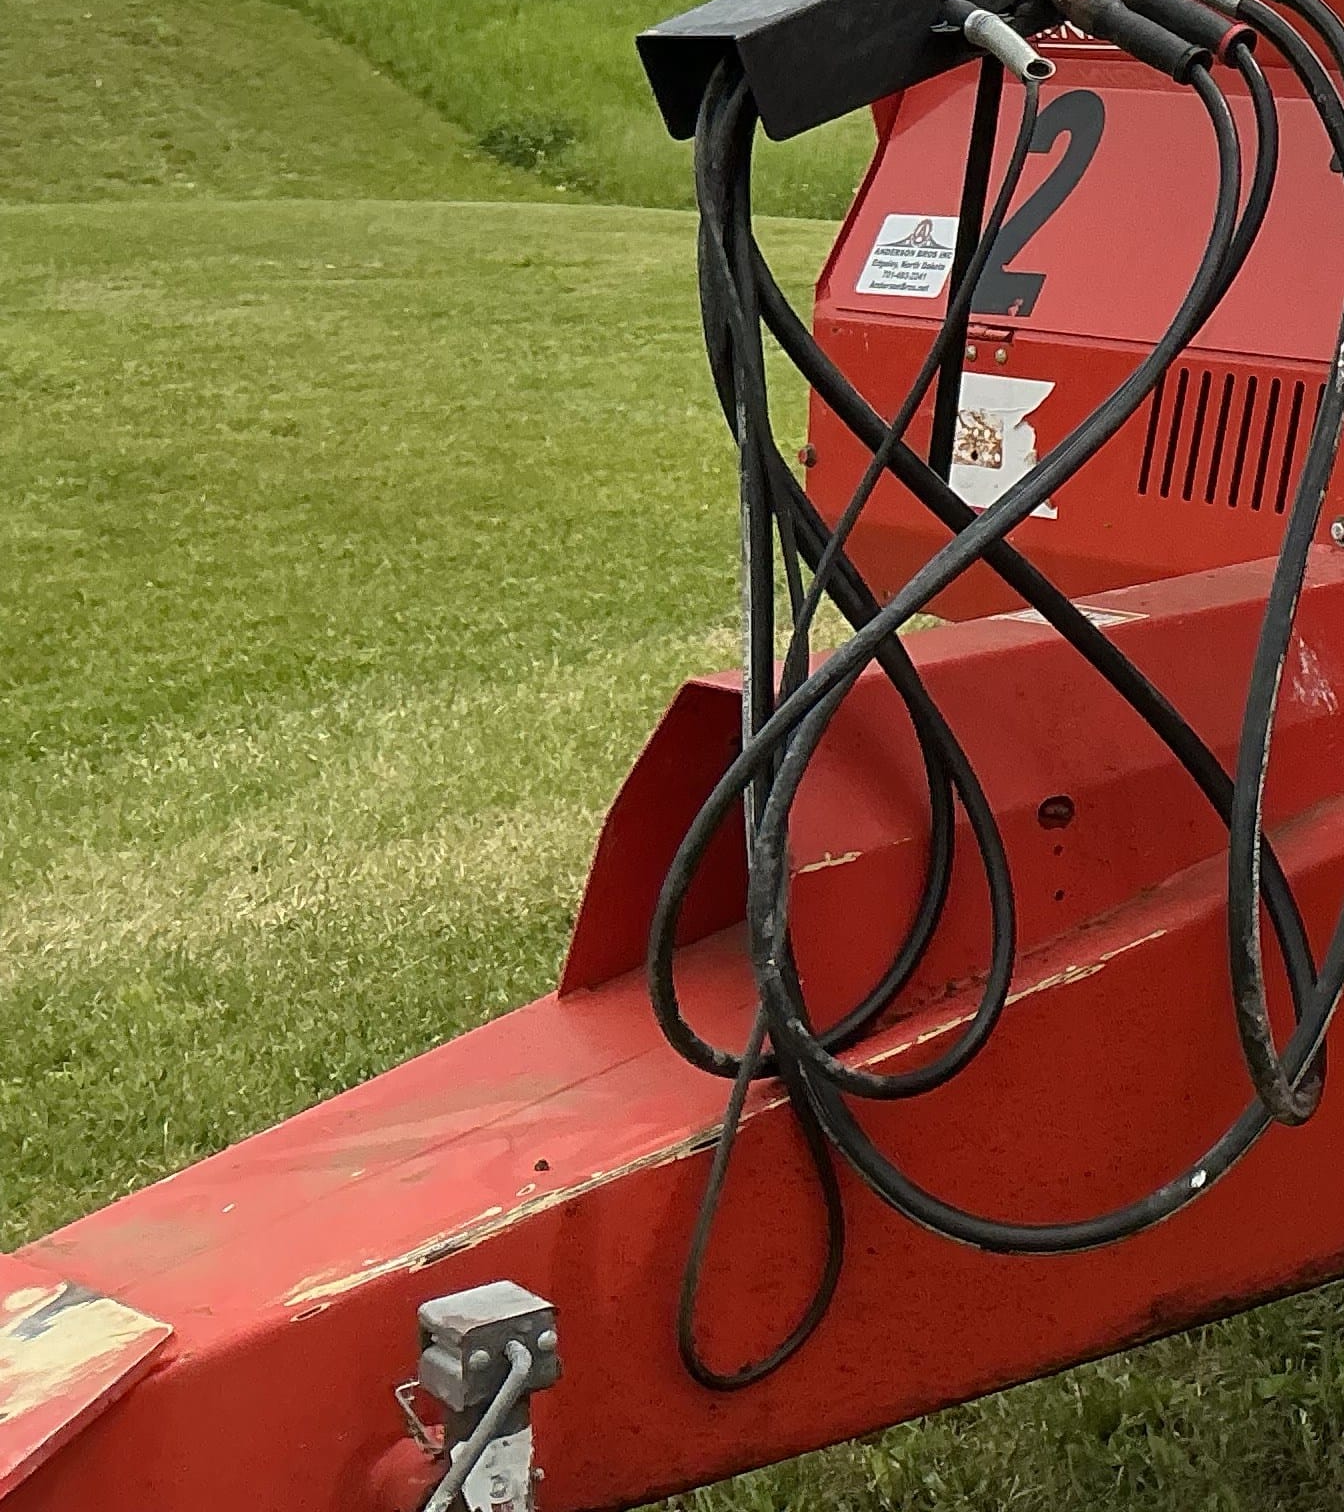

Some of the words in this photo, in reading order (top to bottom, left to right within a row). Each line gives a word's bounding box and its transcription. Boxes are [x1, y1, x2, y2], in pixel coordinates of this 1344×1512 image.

[971, 88, 1106, 317] 2
[873, 248, 915, 257] ANDERSON
[916, 250, 938, 258] BROS
[938, 251, 953, 259] INC
[901, 260, 921, 269] North
[921, 262, 946, 271] Dakota
